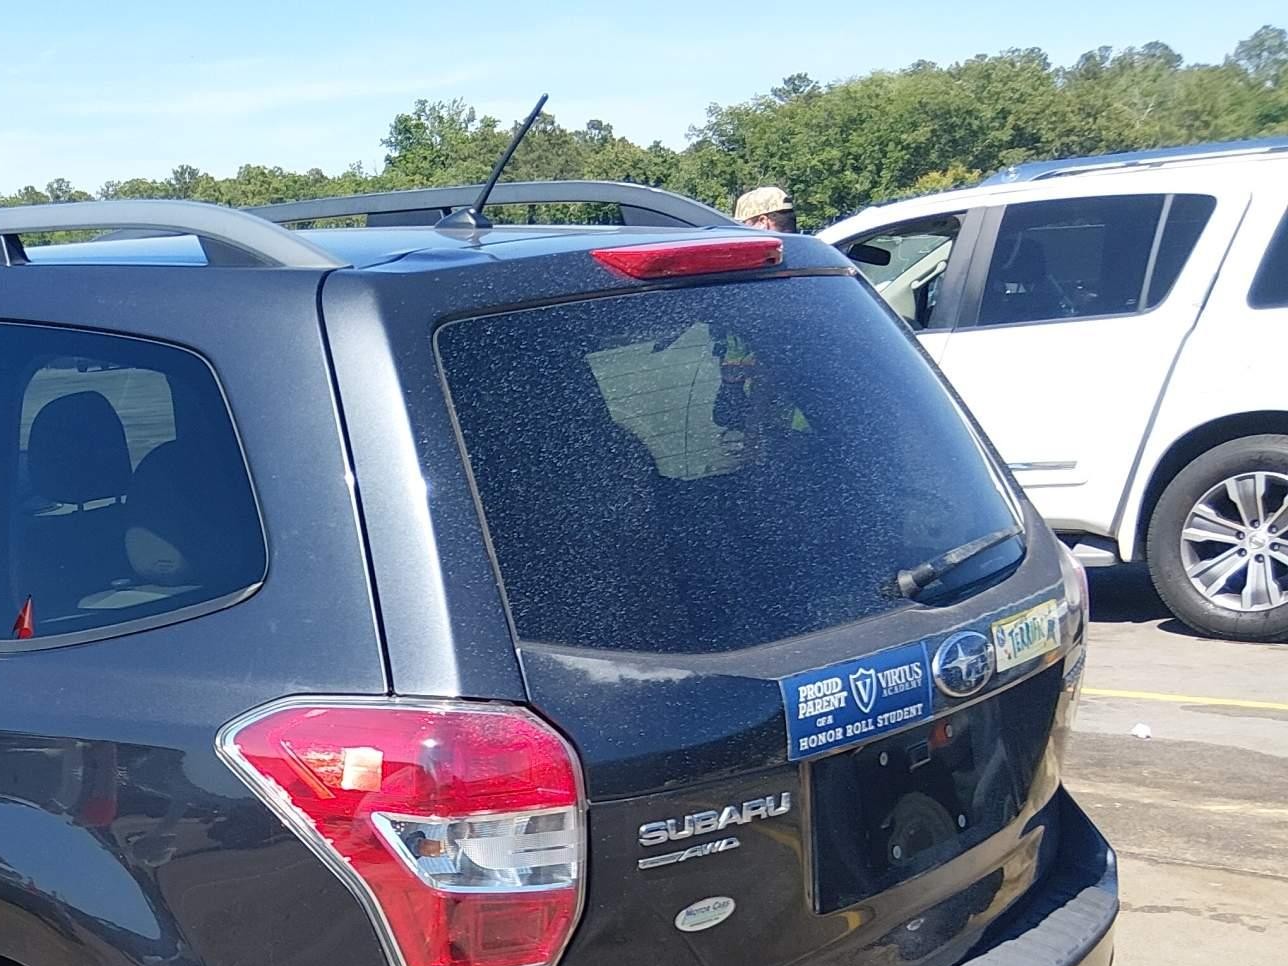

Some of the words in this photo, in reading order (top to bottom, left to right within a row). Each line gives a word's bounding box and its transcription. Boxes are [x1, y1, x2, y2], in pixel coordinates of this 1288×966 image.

[877, 662, 923, 689] VIRTUS
[882, 678, 923, 698] ACADEMY
[798, 677, 842, 702] PROUD
[798, 691, 848, 719] PARENT
[799, 728, 844, 751] HONOR
[845, 719, 875, 737] ROLL
[877, 703, 924, 727] STUDENT
[638, 792, 791, 847] SUBARU
[678, 837, 741, 862] AWD
